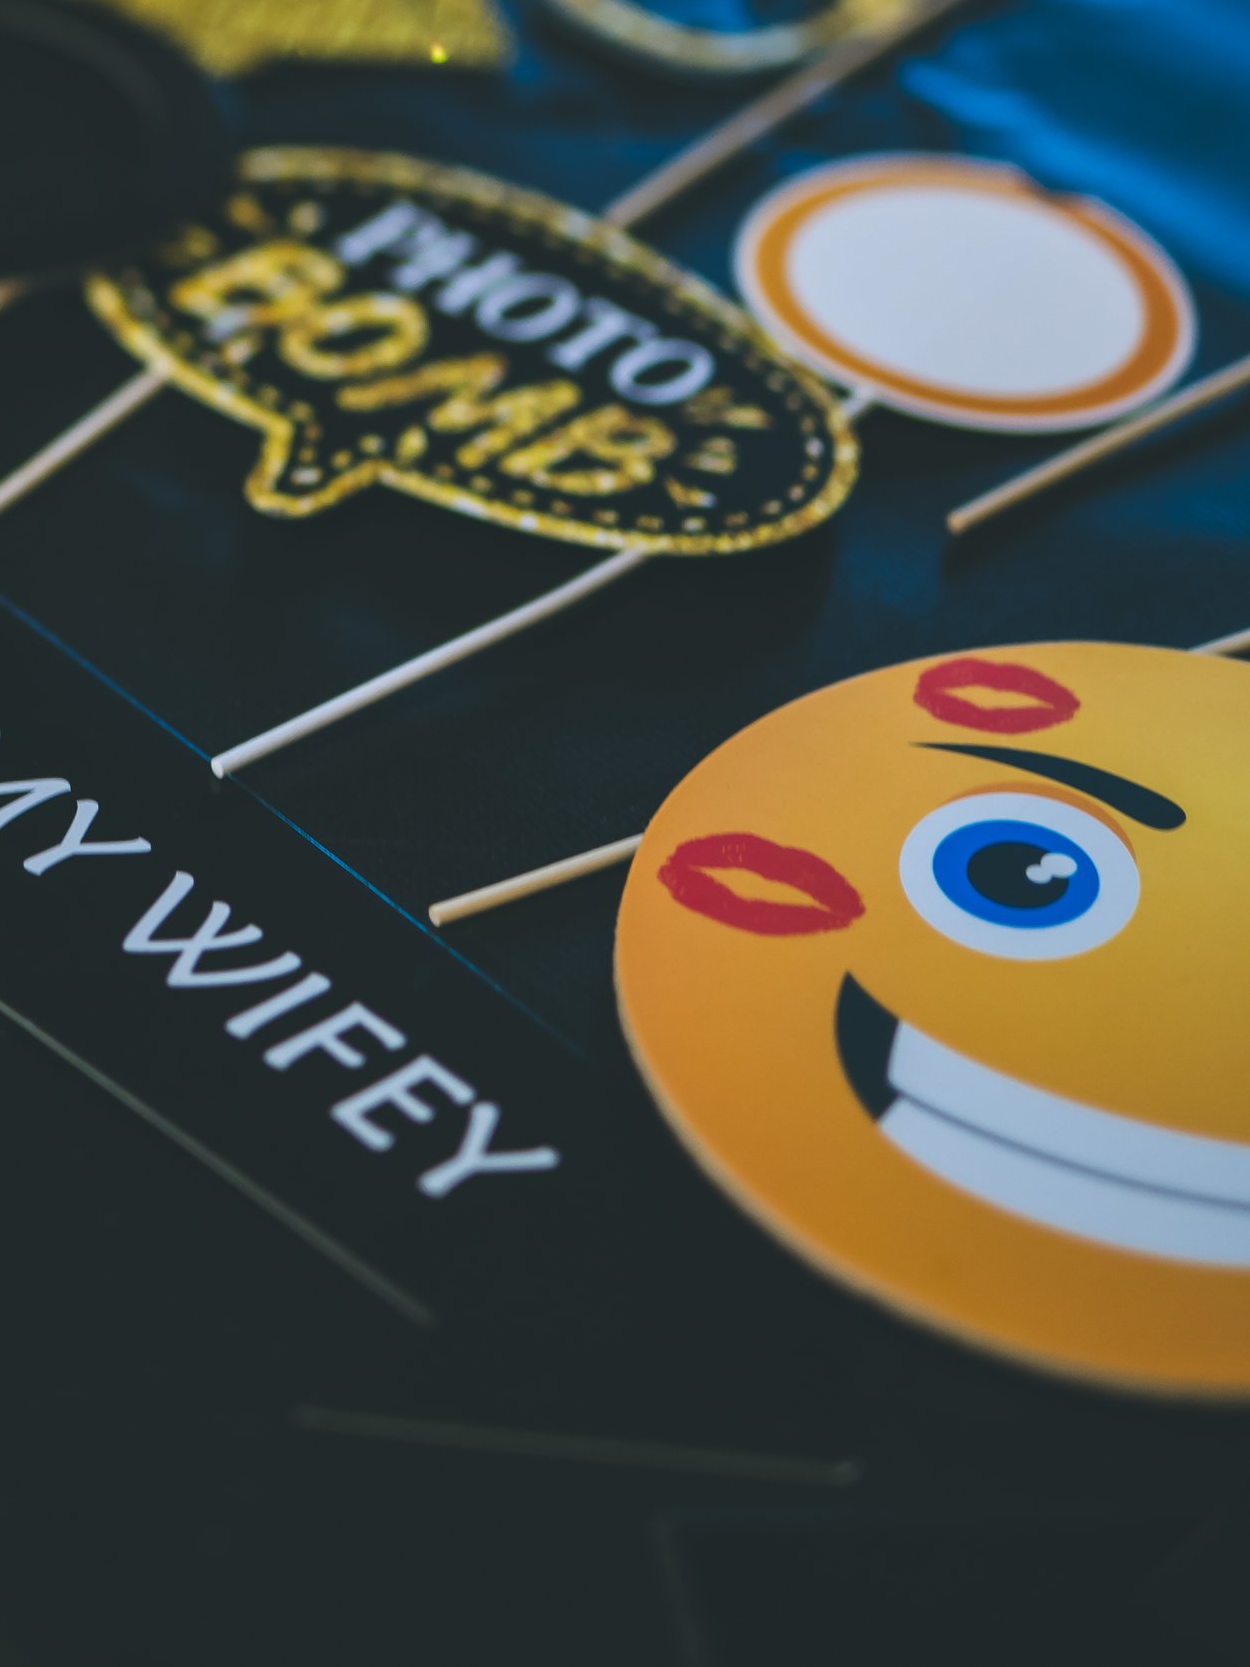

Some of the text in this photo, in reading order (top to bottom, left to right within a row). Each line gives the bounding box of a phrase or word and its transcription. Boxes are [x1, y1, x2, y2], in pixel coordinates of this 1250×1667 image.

[170, 239, 676, 494] BOMB
[338, 200, 716, 406] PHOTO
[122, 870, 560, 1198] WIFEY
